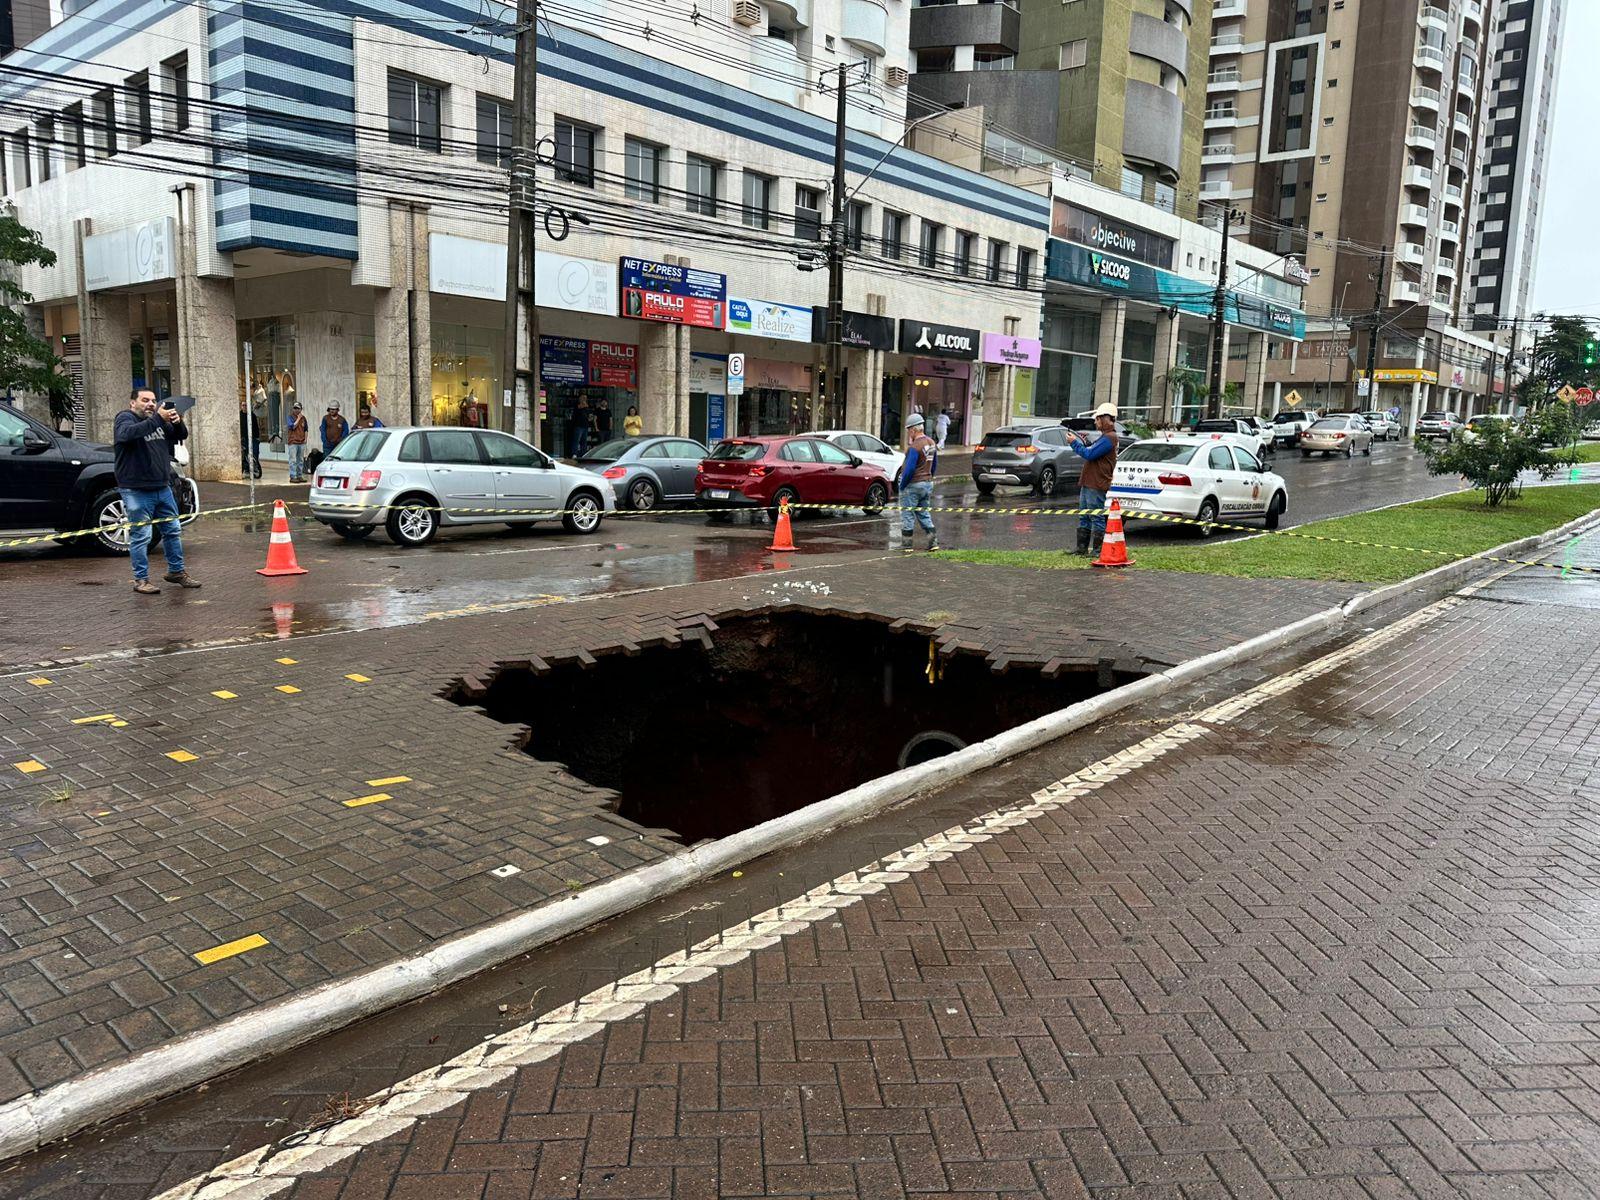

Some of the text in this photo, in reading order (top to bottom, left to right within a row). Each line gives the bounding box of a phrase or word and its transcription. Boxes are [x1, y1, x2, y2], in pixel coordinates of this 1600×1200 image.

[1090, 222, 1137, 252] objective
[624, 258, 682, 277] NET EXPRESS
[1100, 259, 1131, 281] SICOOB
[645, 293, 684, 308] PAULO
[757, 313, 795, 333] Realize
[554, 339, 586, 349] EXPRESS
[592, 343, 634, 357] PAULO
[934, 333, 972, 351] ALCOOL
[733, 360, 739, 372] E
